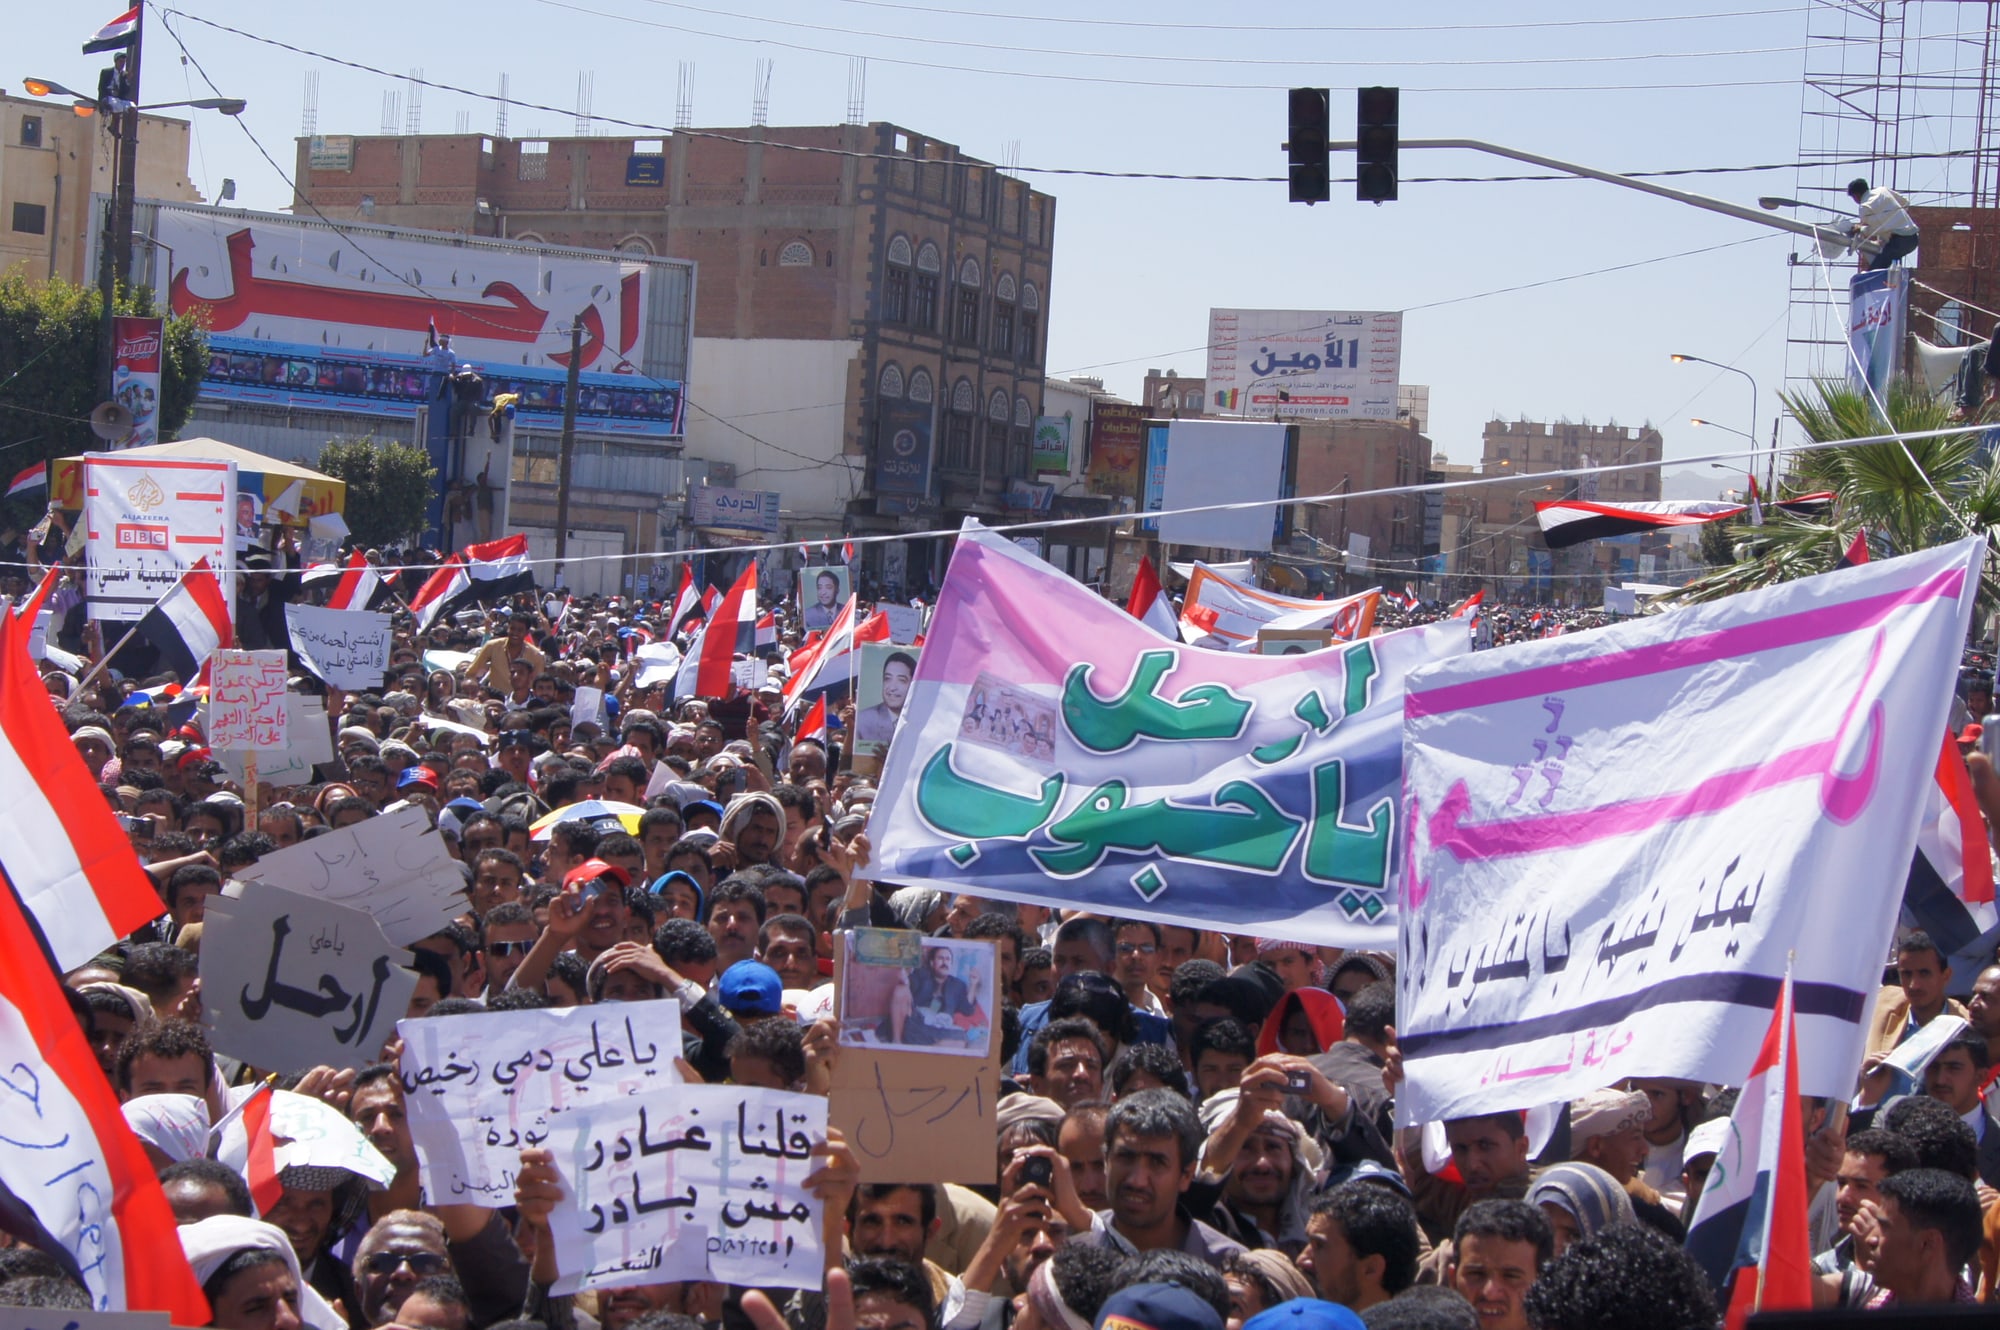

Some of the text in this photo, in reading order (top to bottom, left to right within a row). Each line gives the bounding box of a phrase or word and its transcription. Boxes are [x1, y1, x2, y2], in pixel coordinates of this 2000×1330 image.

[1250, 331, 1358, 377] الأمين
[120, 529, 166, 546] BBC
[121, 513, 170, 522] ALJAZEERA
[583, 1100, 813, 1172] قلنا غادر
[583, 1171, 810, 1233] مش بادر
